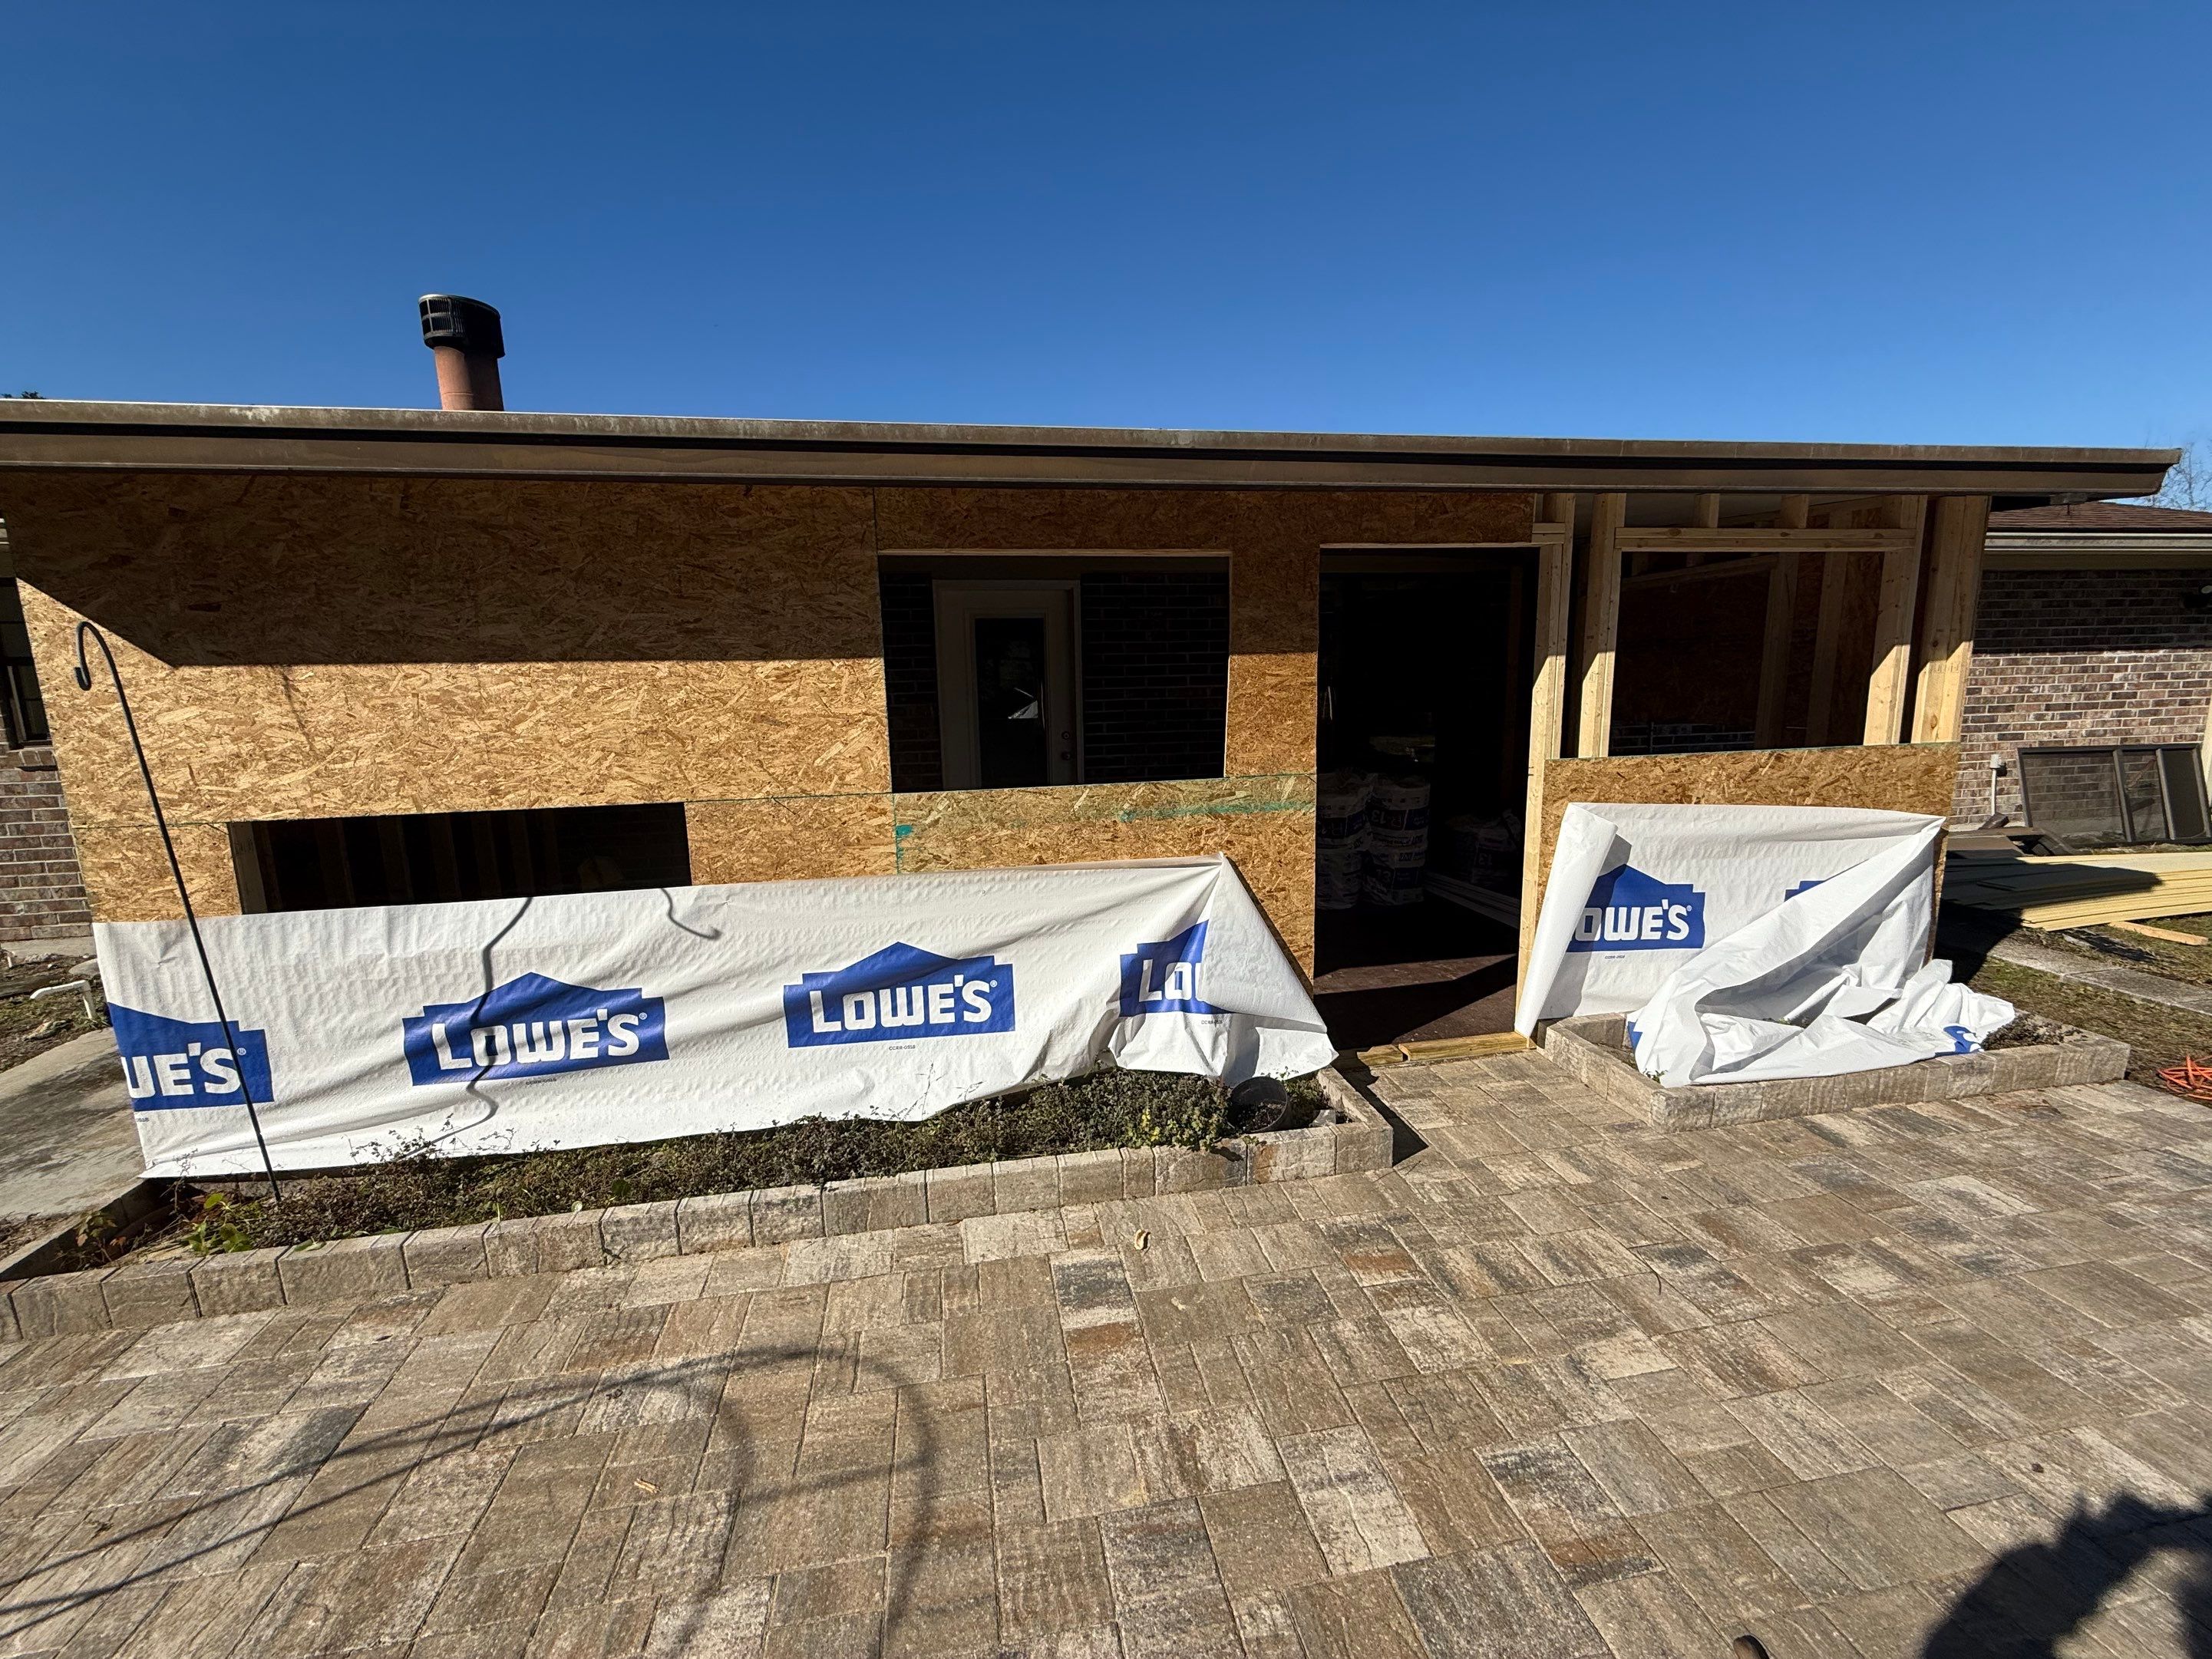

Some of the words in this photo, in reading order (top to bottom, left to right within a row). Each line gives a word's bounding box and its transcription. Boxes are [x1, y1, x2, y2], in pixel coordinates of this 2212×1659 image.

[1575, 899, 1689, 942] OWE'S
[810, 975, 992, 1034] LOWE'S
[432, 1008, 639, 1070] LOWE'S
